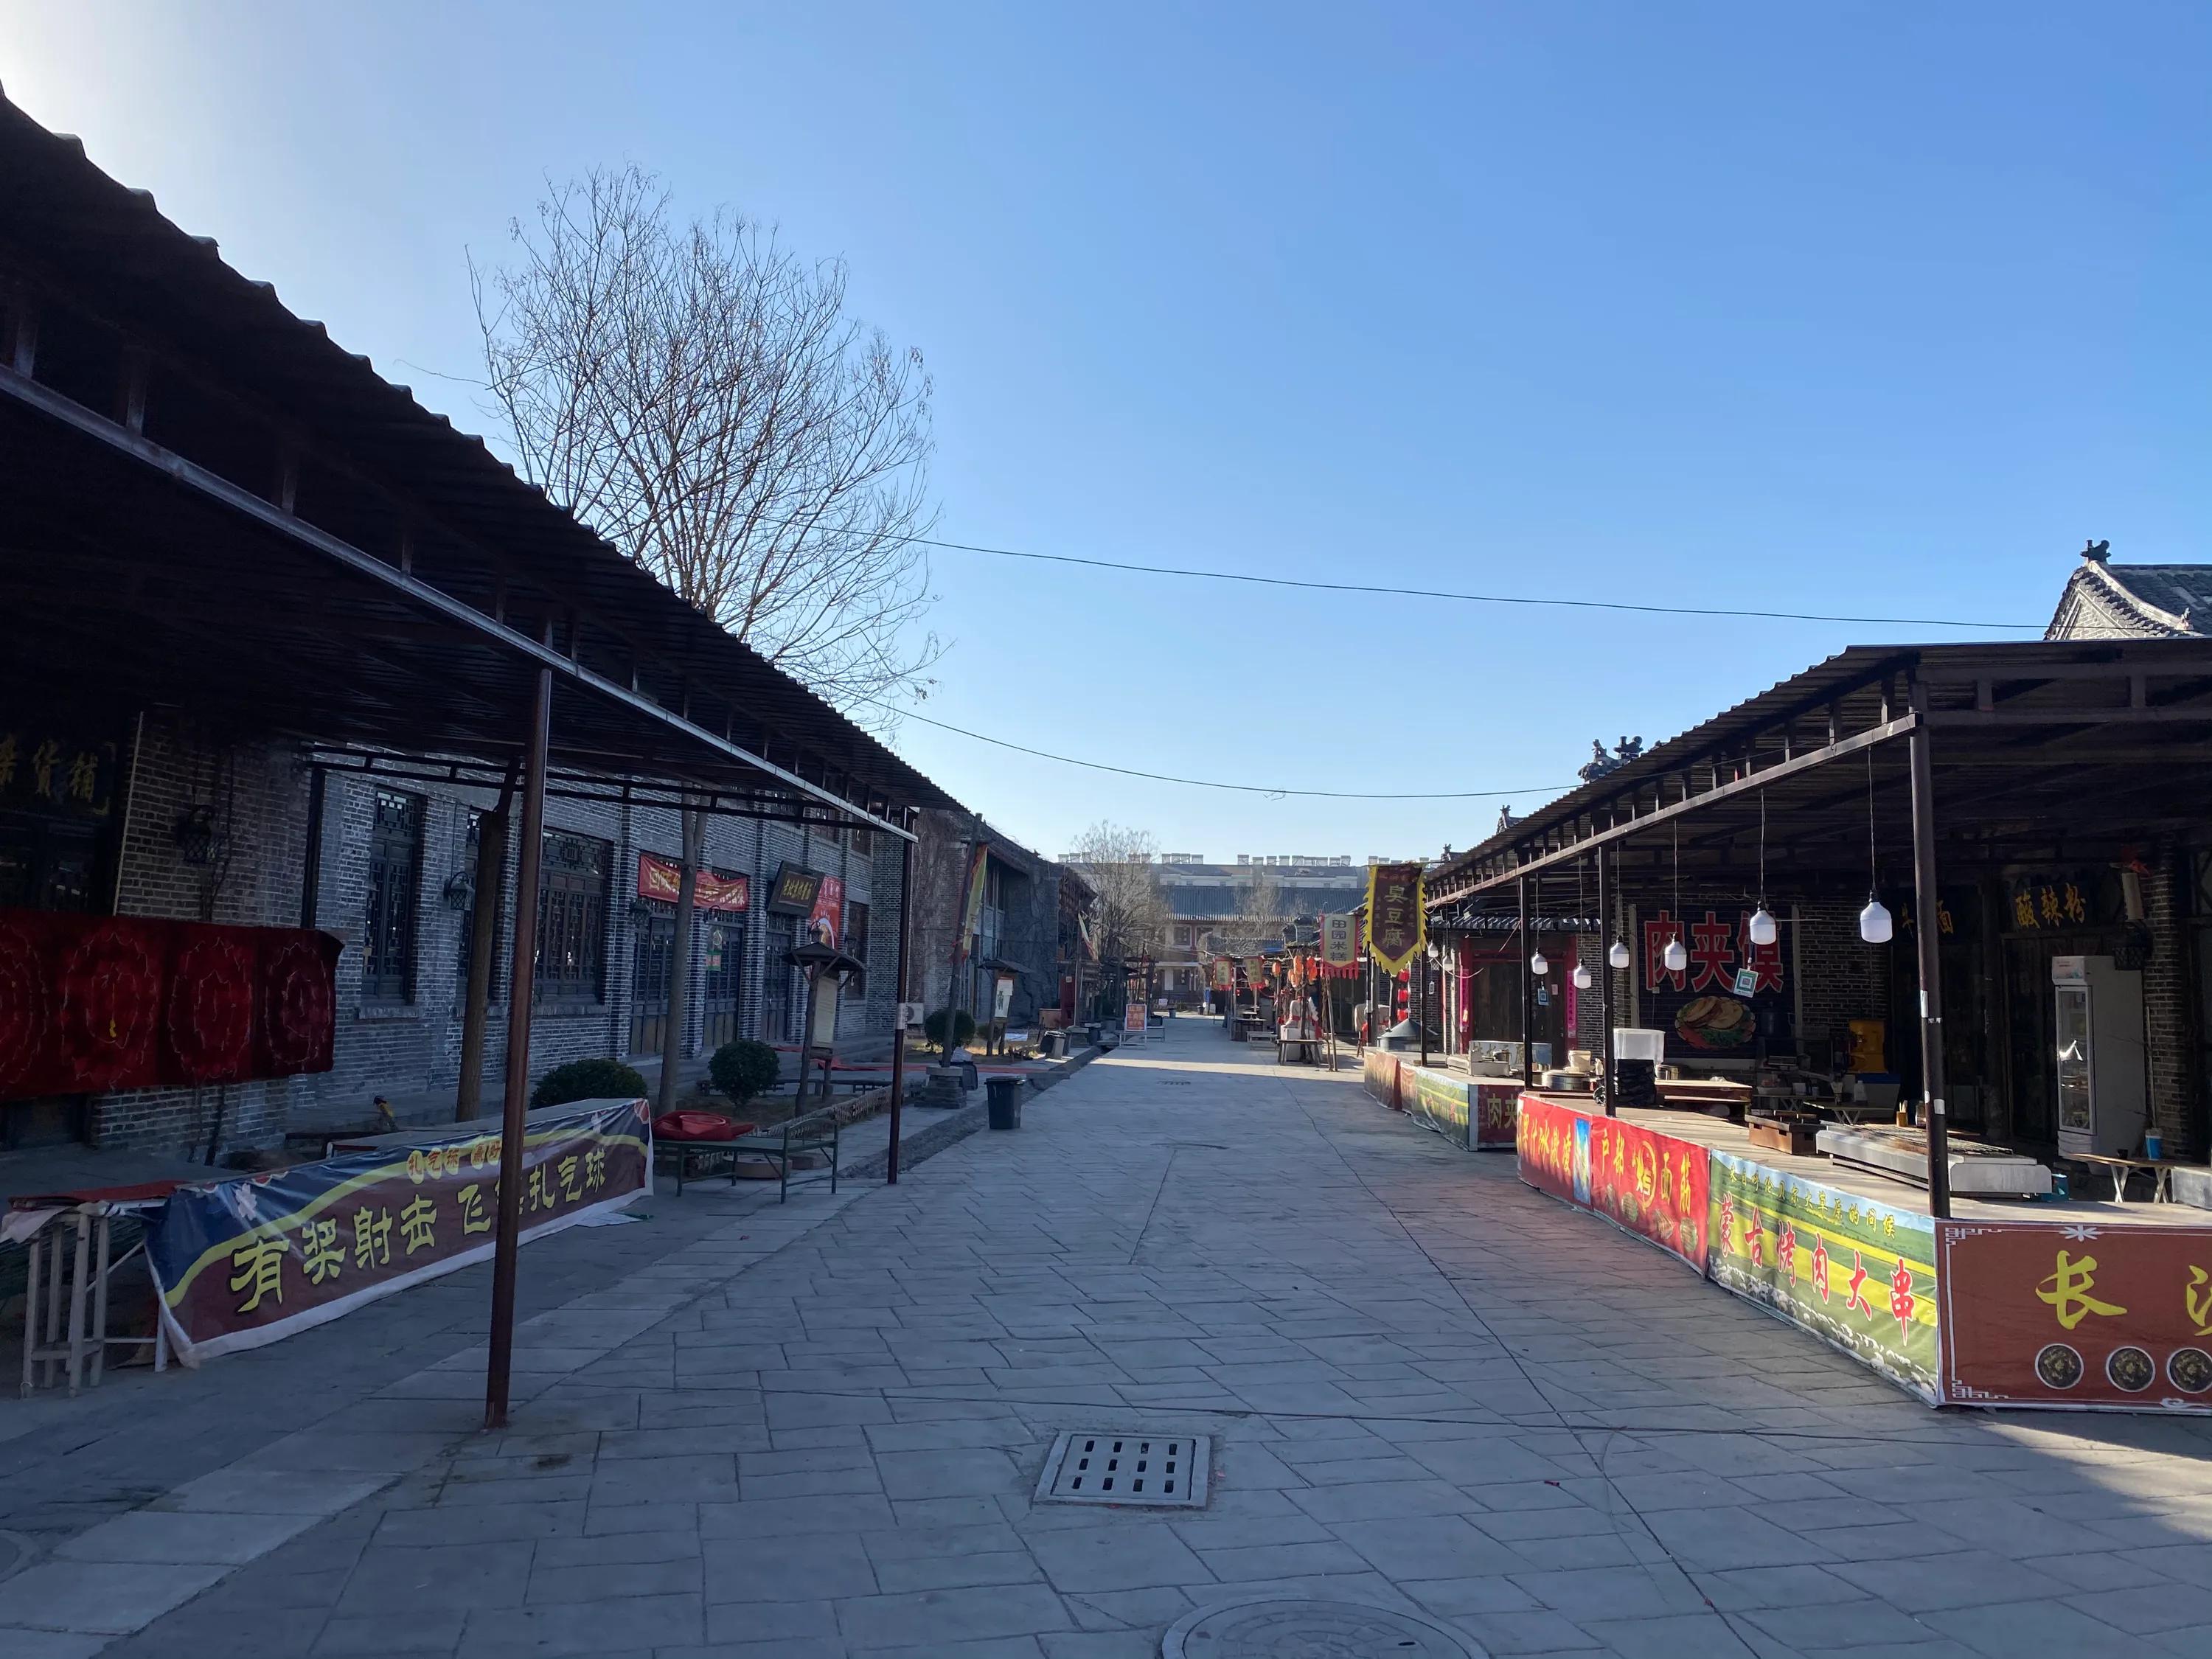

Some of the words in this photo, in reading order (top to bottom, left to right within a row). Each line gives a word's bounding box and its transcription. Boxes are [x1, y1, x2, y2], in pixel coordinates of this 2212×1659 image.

[1385, 885, 1408, 948] 臭豆腐
[230, 1194, 437, 1314] 有奖射击
[457, 1148, 606, 1236] 飞扎气球
[1719, 1191, 1915, 1346] 蒙古烤肉大串
